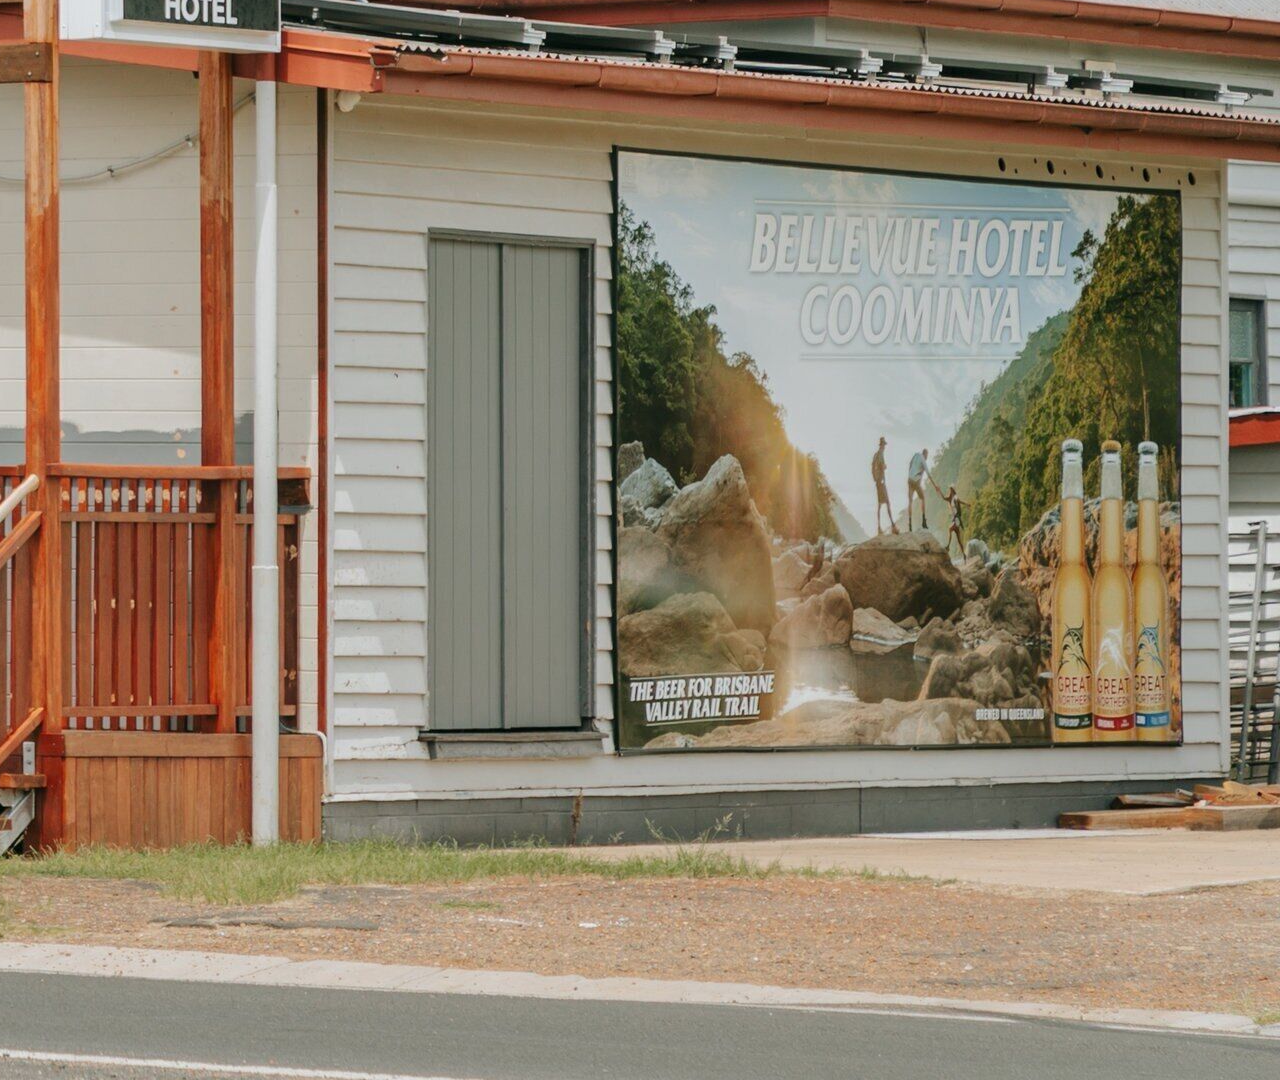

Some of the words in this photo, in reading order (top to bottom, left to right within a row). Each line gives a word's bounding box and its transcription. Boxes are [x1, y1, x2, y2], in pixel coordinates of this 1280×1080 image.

[749, 213, 940, 276] BELLEVUE
[948, 218, 1067, 278] HOTEL
[799, 284, 1022, 346] COOMINYA
[630, 681, 654, 702] THE
[655, 679, 686, 700] BEER
[687, 677, 713, 698] FOR
[714, 674, 775, 696] BRISBANE
[1057, 675, 1092, 693] GREAT
[1096, 677, 1130, 695] GREAT
[1134, 674, 1167, 692] GREAT
[645, 700, 694, 722] VALLEY
[691, 697, 722, 719] RAIL
[724, 695, 761, 717] TRAIL
